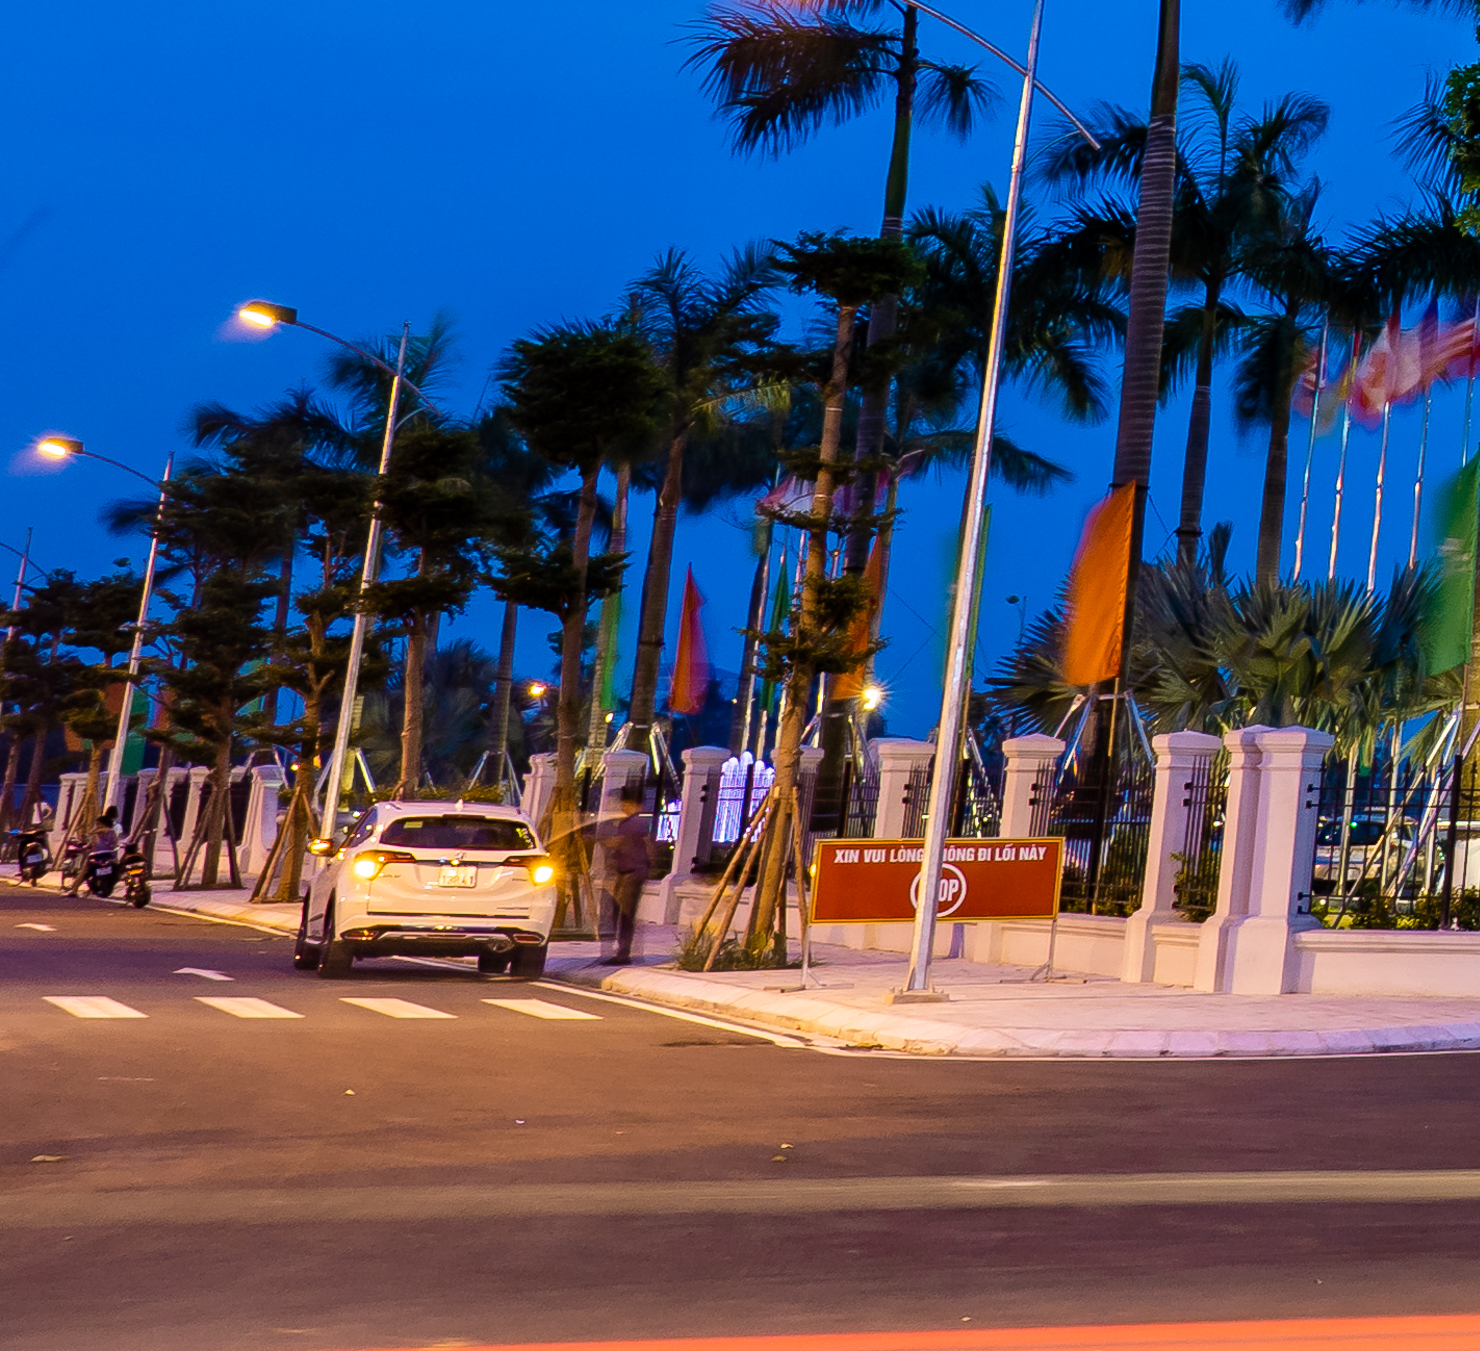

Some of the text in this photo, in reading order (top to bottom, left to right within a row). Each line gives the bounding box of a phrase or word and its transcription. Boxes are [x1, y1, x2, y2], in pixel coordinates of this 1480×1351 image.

[834, 843, 1047, 863] XIN VUI LÒNG ÔNG ĐI LỐI NÀY
